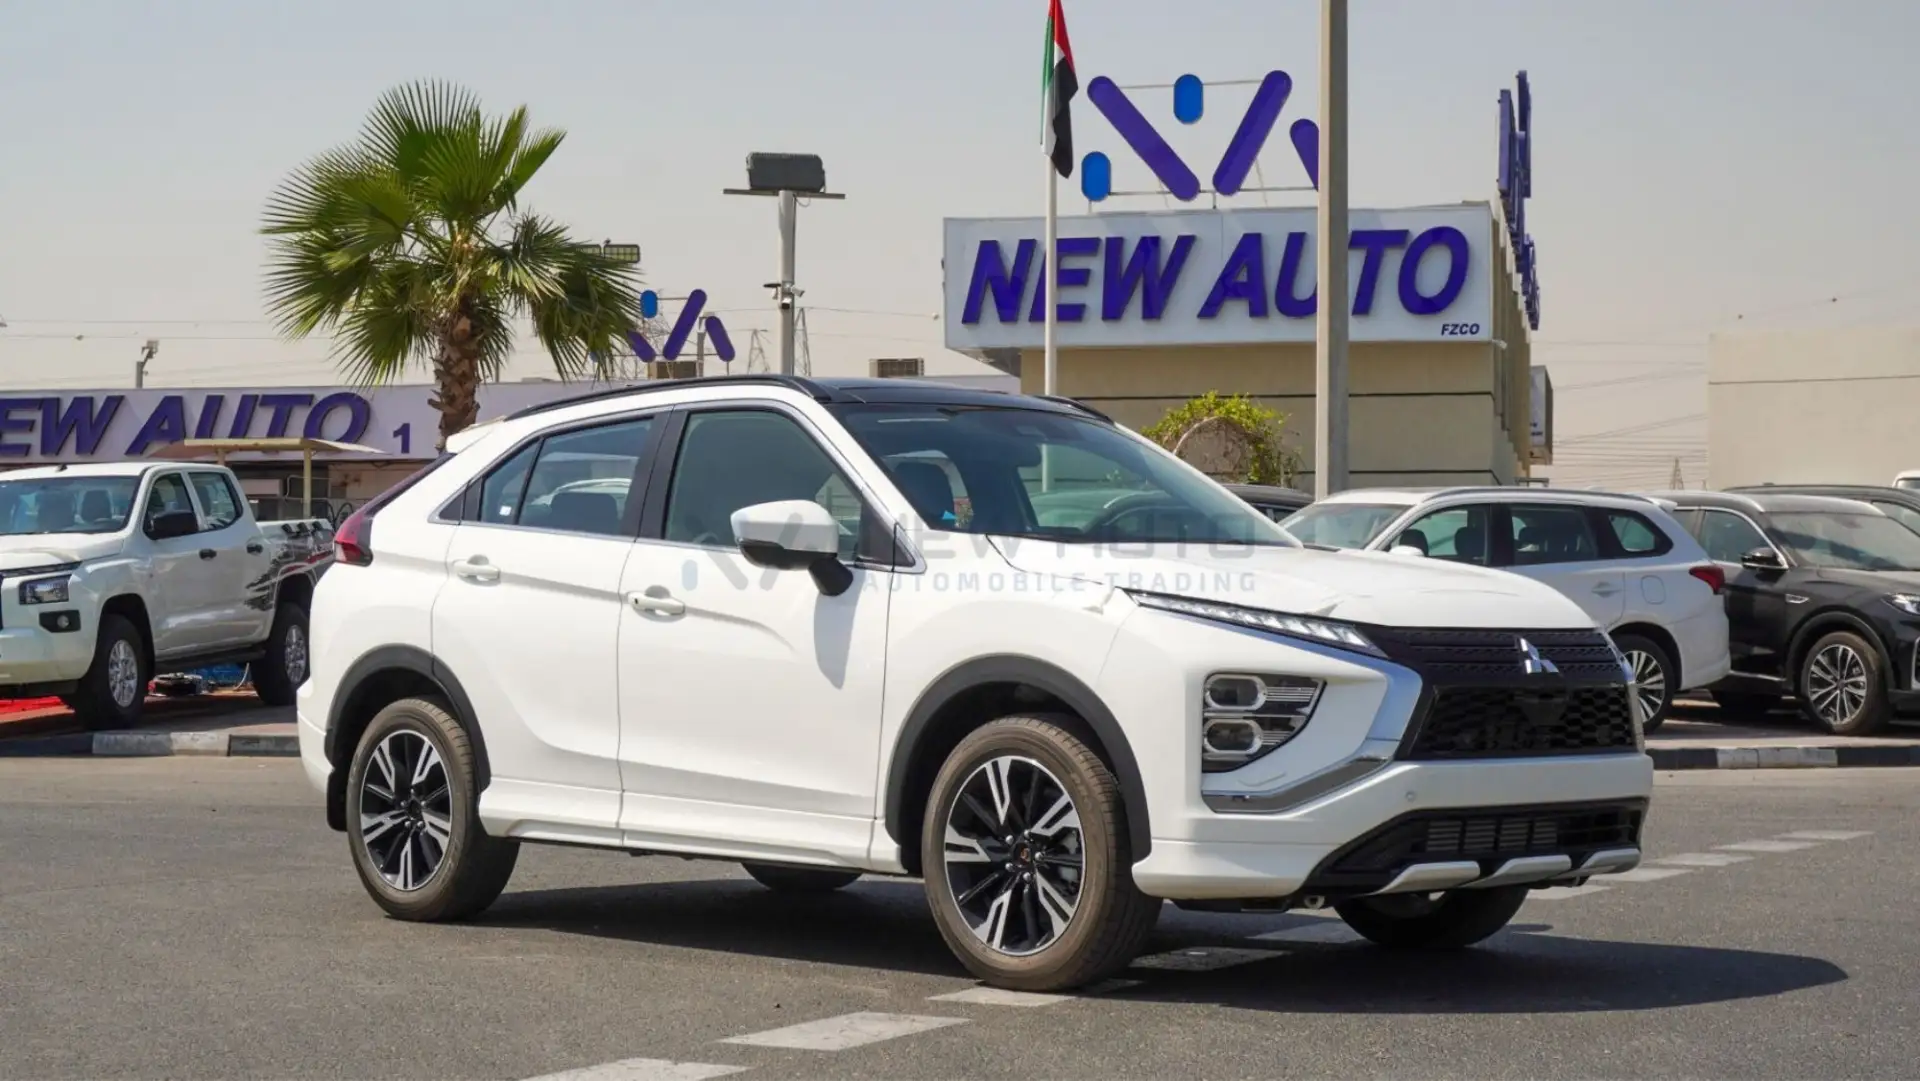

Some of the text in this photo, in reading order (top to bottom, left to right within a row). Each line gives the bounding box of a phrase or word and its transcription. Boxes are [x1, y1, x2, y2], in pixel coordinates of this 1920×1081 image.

[961, 234, 1197, 324] NEW
[1197, 226, 1470, 316] AUTO
[1441, 323, 1480, 336] FZCO
[125, 392, 372, 456] AUTO
[393, 422, 411, 454] 1
